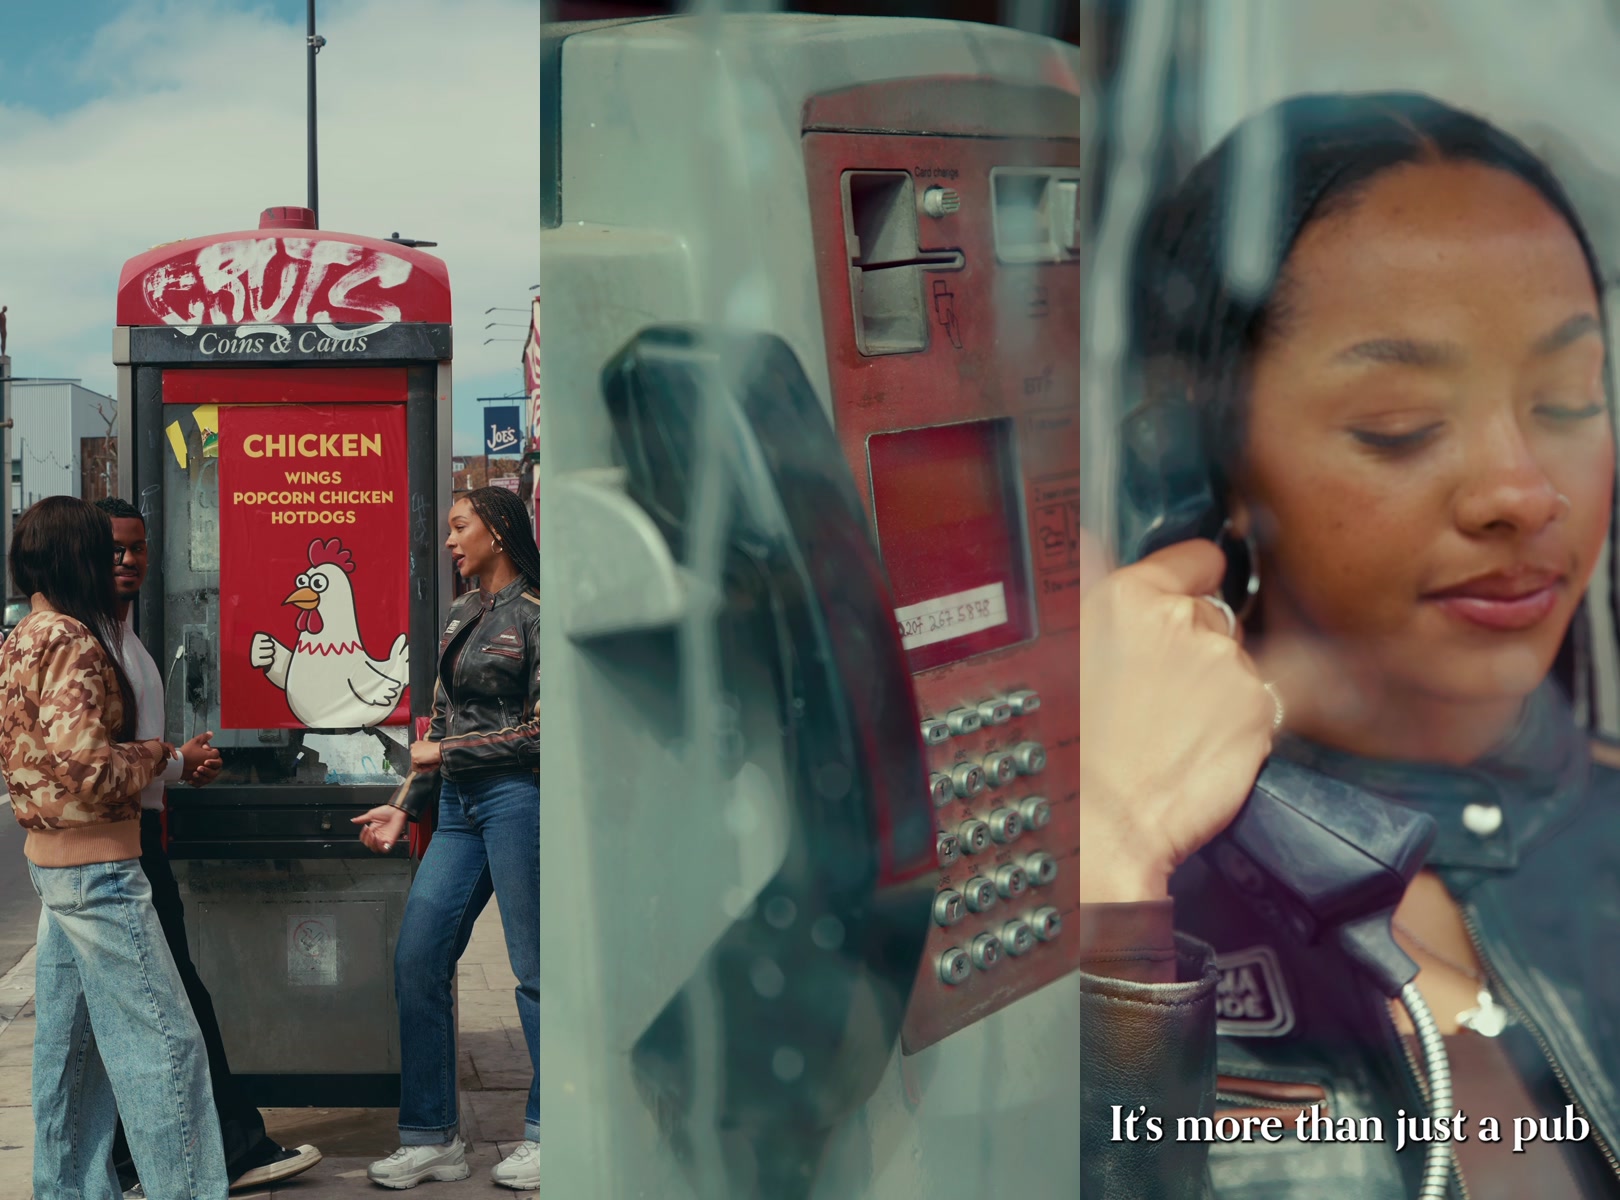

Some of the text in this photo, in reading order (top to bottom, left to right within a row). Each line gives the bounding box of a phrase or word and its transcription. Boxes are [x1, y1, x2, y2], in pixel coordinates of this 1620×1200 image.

[199, 330, 368, 355] Coins & Cards
[243, 433, 382, 458] CHICKEN
[284, 471, 342, 485] WINGS
[233, 491, 315, 505] POPCORN
[319, 490, 394, 504] CHICKEN
[271, 511, 356, 524] HOTDOGS
